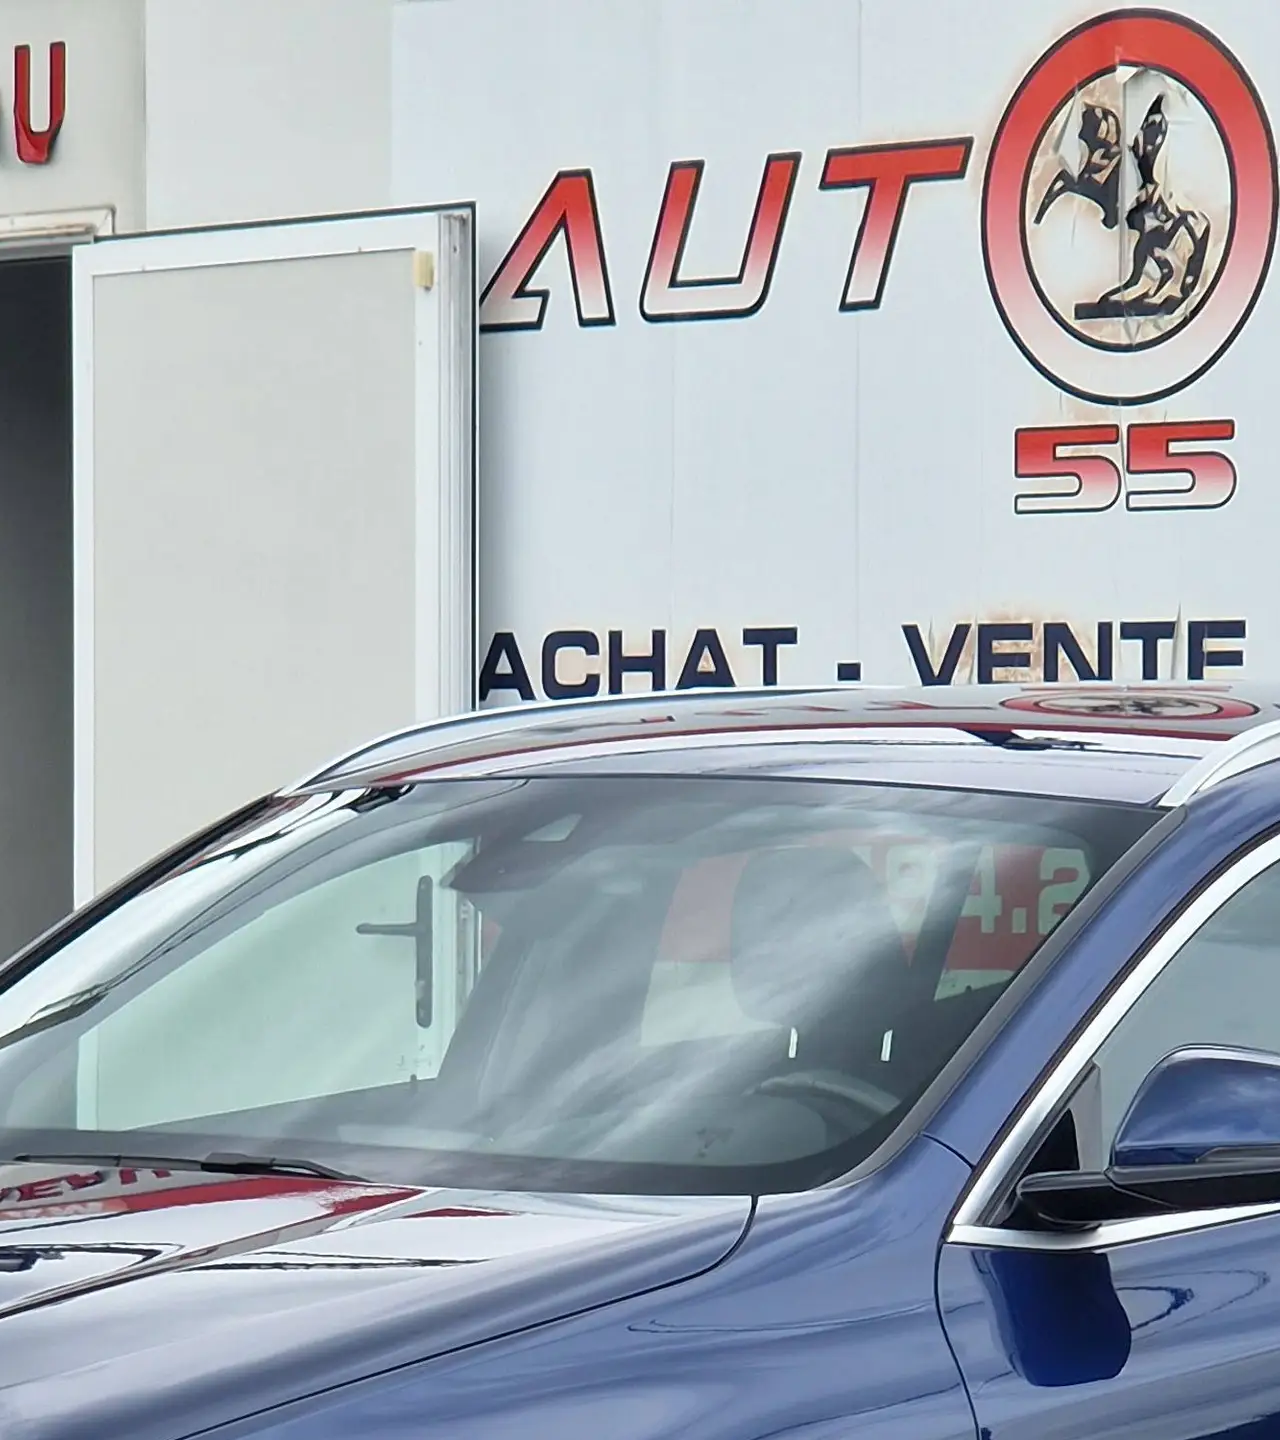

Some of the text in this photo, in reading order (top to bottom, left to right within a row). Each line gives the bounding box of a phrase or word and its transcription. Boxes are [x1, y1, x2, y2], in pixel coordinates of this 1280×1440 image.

[1013, 419, 1238, 515] 55
[480, 626, 798, 702] ACHAT
[901, 619, 1246, 687] VENTE
